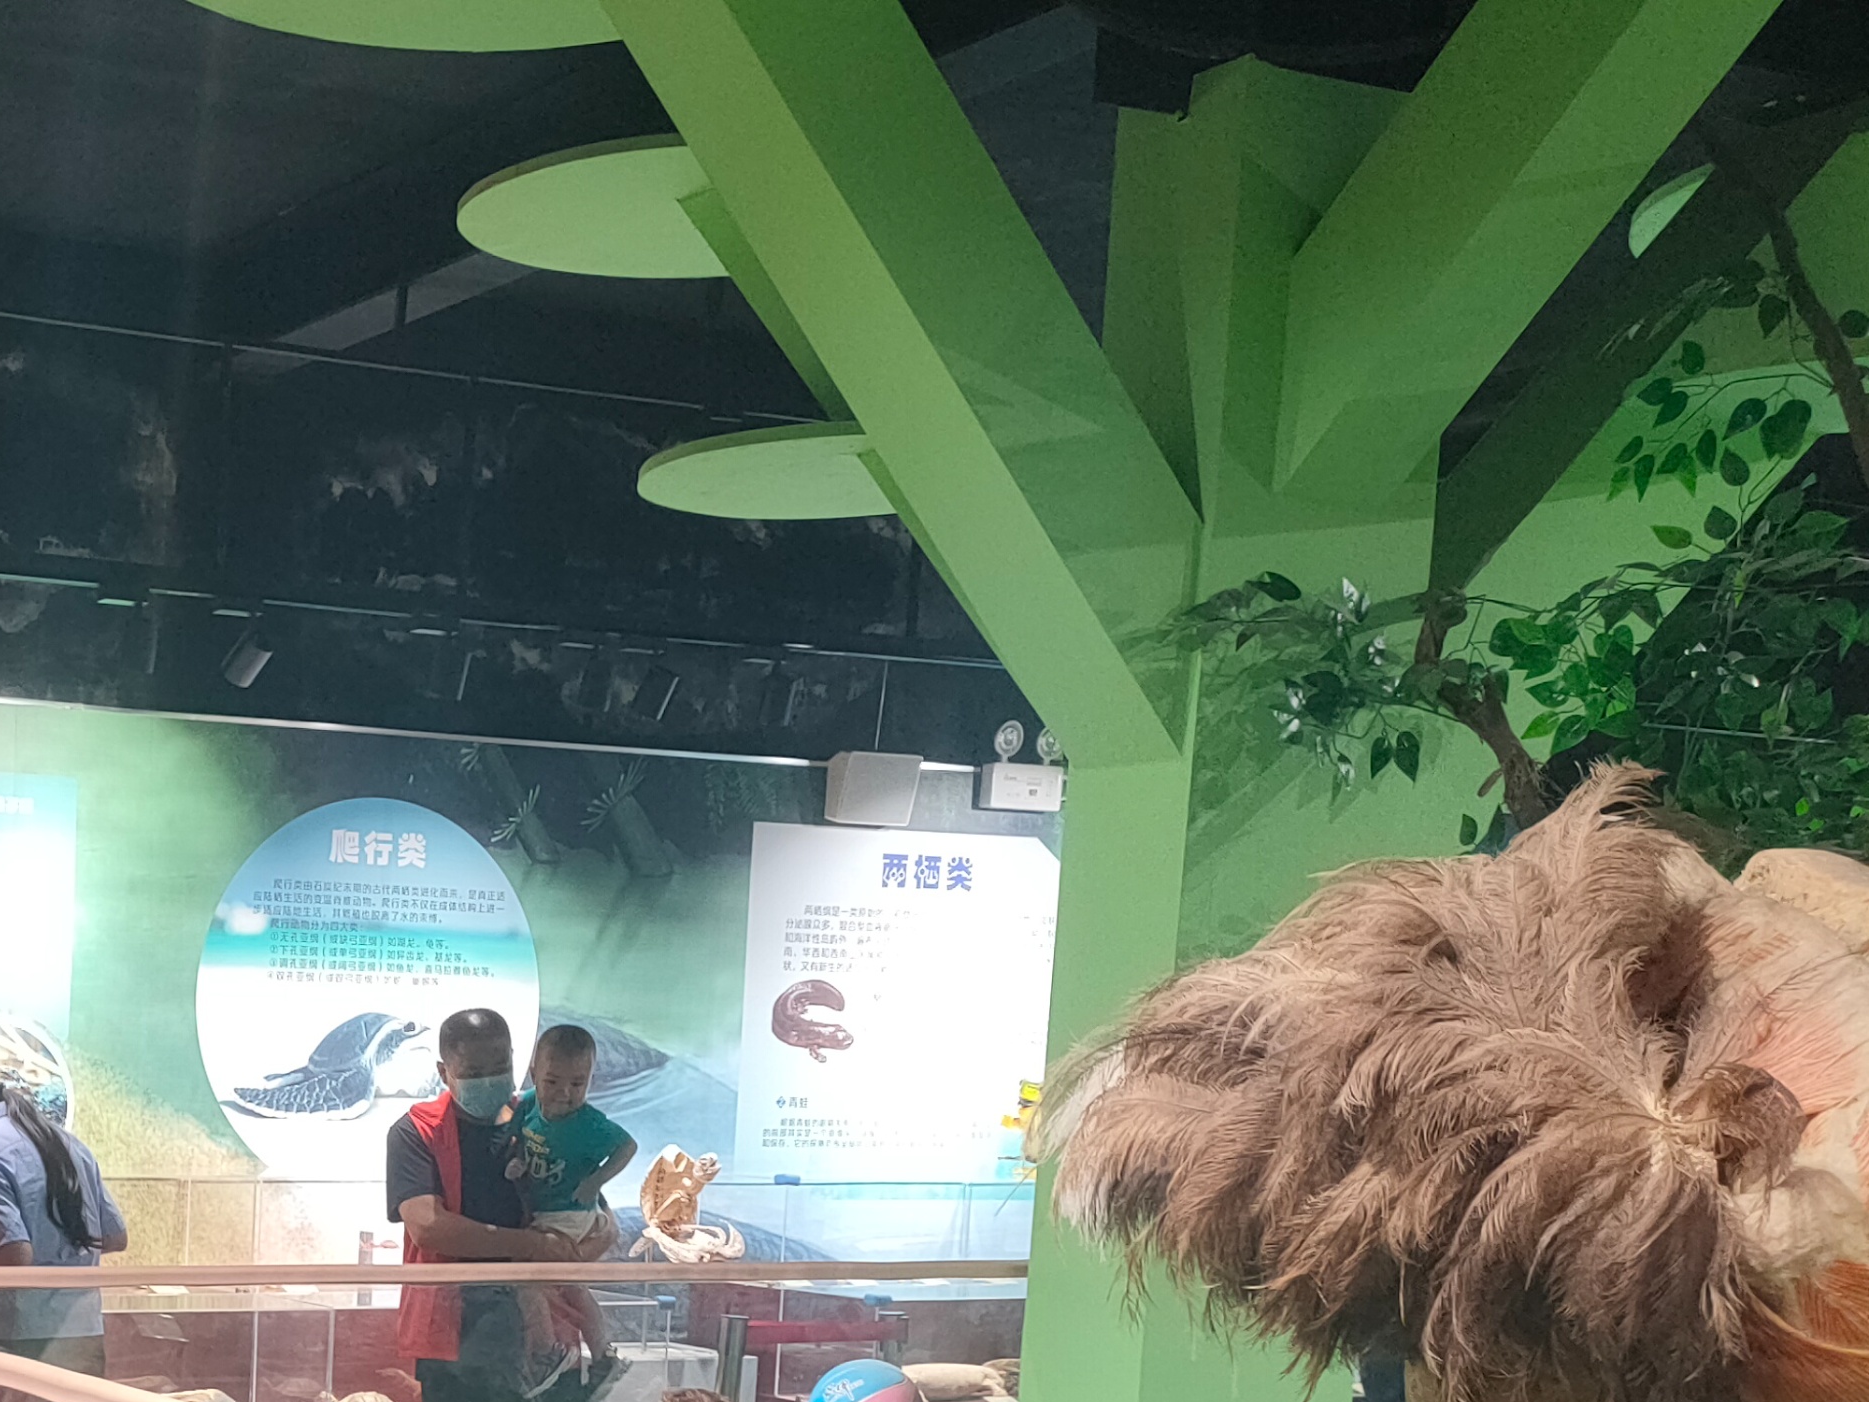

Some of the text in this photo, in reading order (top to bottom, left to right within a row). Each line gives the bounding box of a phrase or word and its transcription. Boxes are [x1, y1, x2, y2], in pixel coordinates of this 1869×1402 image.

[328, 828, 427, 869] 爬行类
[882, 853, 973, 891] 两栖类
